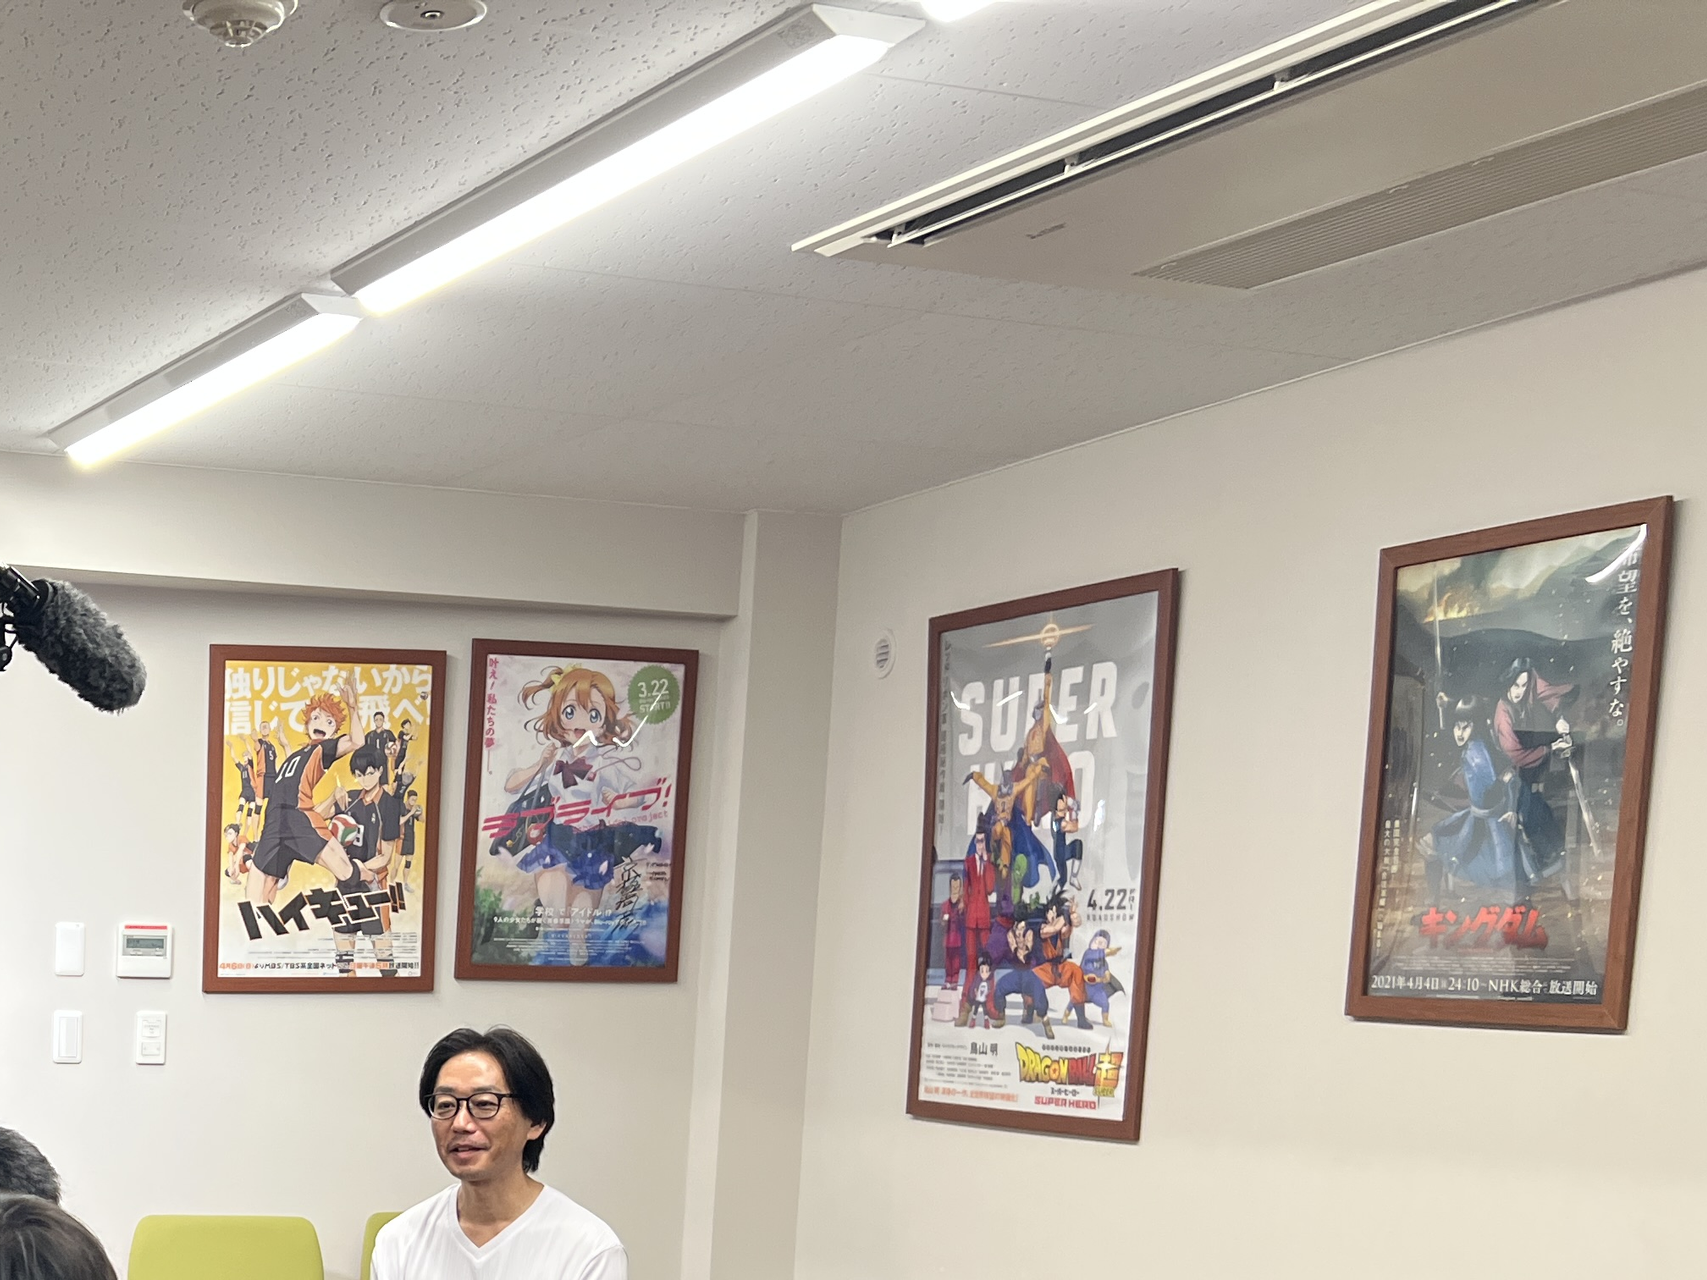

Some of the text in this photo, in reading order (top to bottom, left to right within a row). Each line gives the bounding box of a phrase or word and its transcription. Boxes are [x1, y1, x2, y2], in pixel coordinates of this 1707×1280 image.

[637, 679, 670, 698] 3.22
[958, 661, 1118, 756] SUPER
[275, 755, 301, 783] 10
[967, 750, 1096, 836] HO
[1086, 888, 1128, 911] 4.22
[1419, 905, 1549, 951] キングダム
[1015, 1042, 1068, 1084] DRAGON
[1034, 1096, 1067, 1108] SUPER
